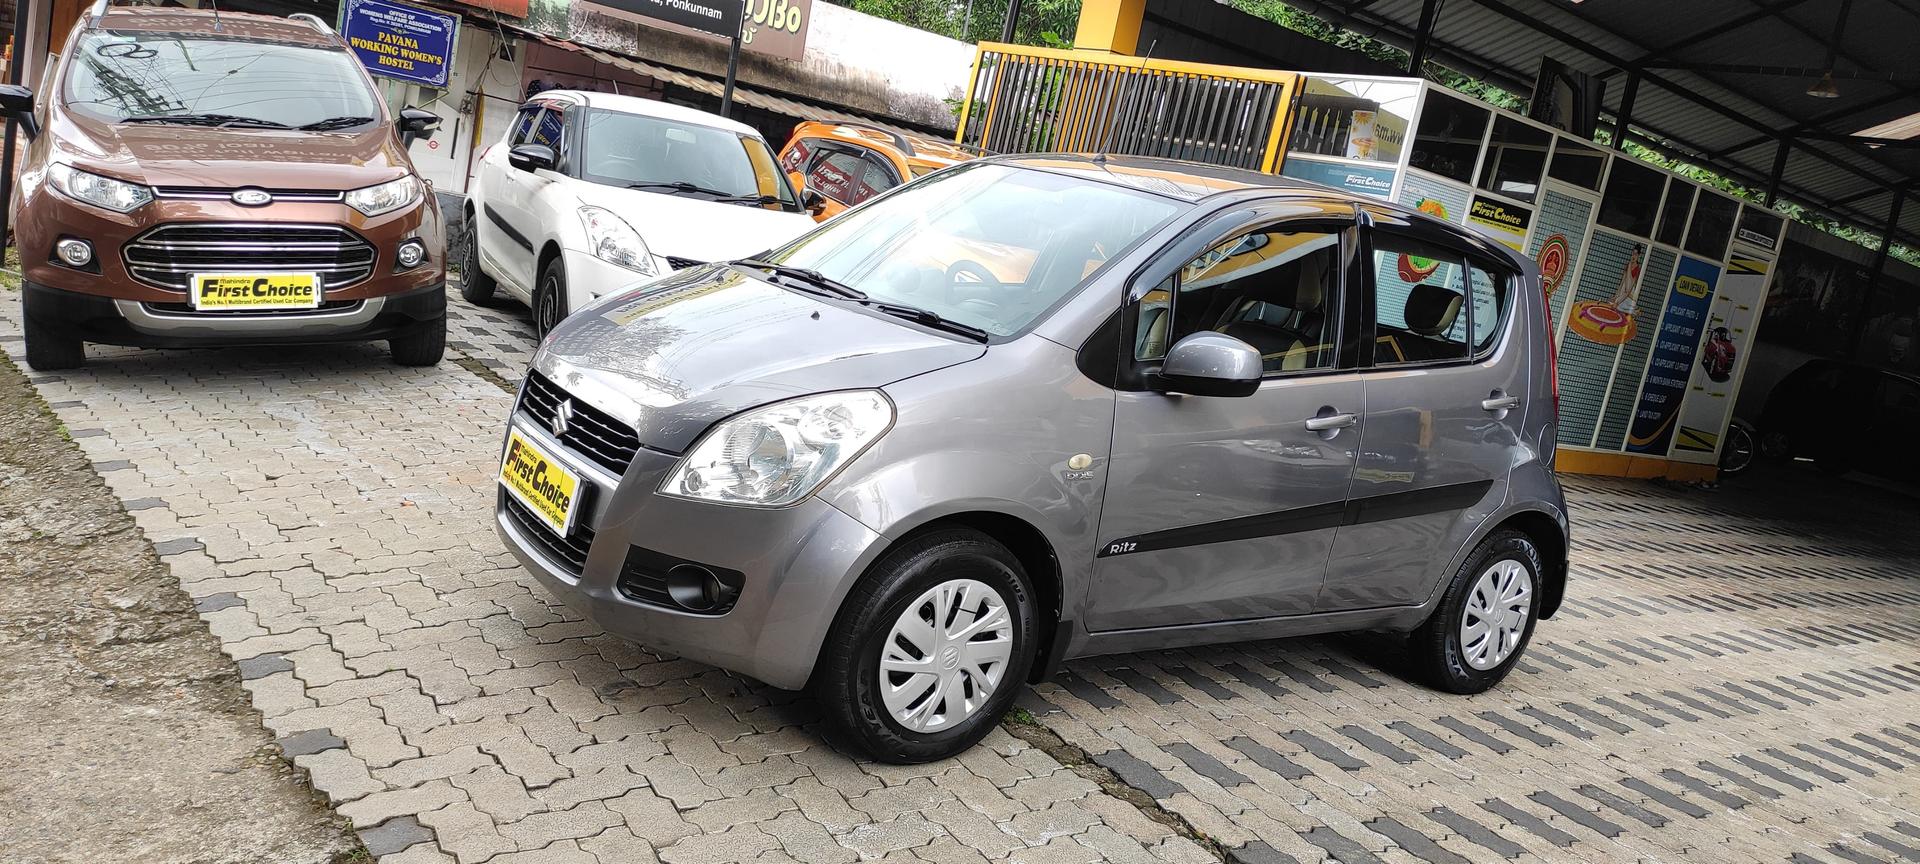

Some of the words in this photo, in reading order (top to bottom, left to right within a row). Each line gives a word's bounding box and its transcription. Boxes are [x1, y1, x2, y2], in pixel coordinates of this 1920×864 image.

[408, 20, 442, 32] ASSOCIATION
[378, 32, 418, 49] PAVANA
[350, 37, 399, 56] WORKING
[400, 48, 443, 65] WOMEN'S
[378, 55, 414, 70] HOSTEL
[1345, 174, 1366, 185] First
[1366, 176, 1391, 187] Choice
[1472, 201, 1495, 217] First
[1494, 207, 1521, 225] Choice
[201, 279, 250, 297] First
[252, 278, 312, 297] Choice
[506, 438, 534, 483] First
[532, 460, 570, 513] Choice
[1109, 542, 1137, 554] Ritz
